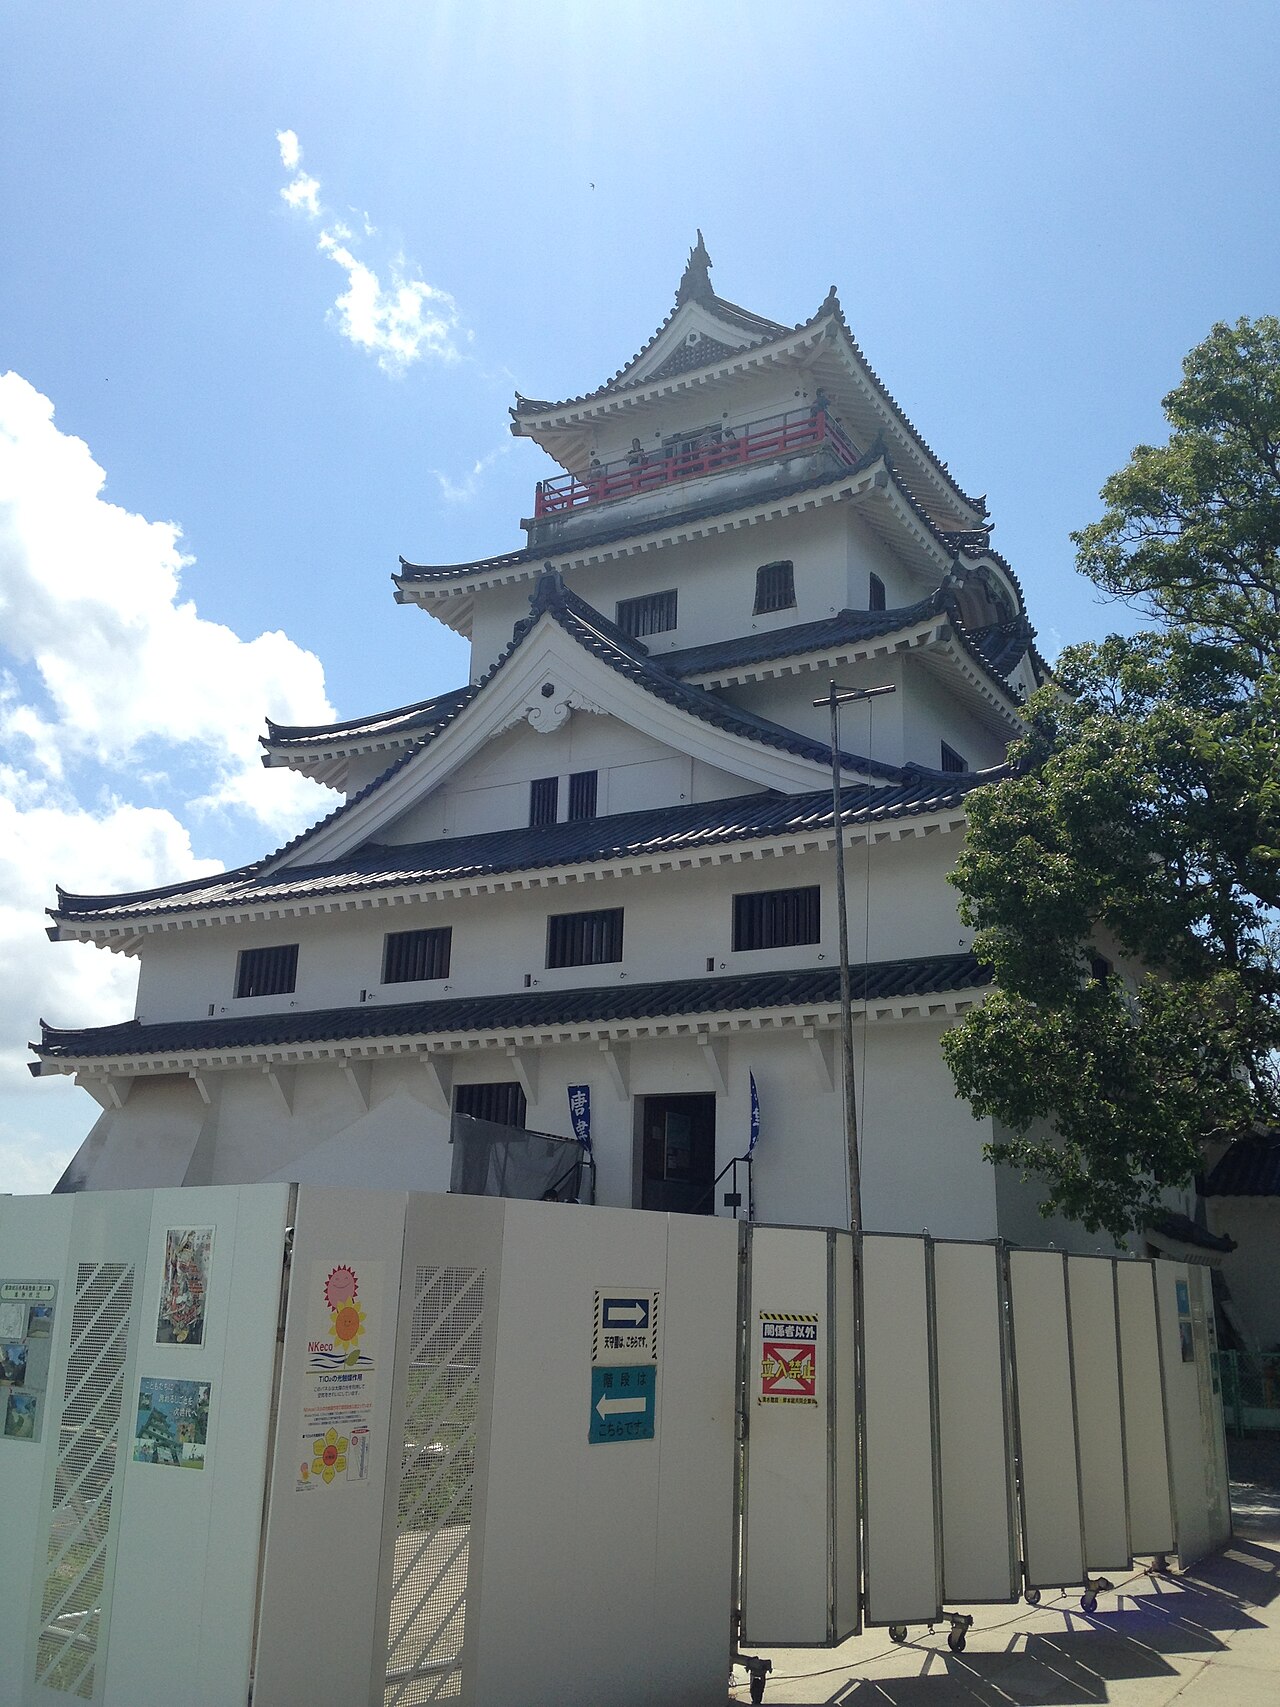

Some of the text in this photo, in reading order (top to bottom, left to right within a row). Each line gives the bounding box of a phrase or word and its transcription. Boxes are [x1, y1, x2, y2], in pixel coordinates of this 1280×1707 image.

[763, 1324, 816, 1339] 関係者以外
[308, 1341, 334, 1353] NKeco
[761, 1359, 816, 1380] 立入禁止
[603, 1372, 647, 1388] 階段は
